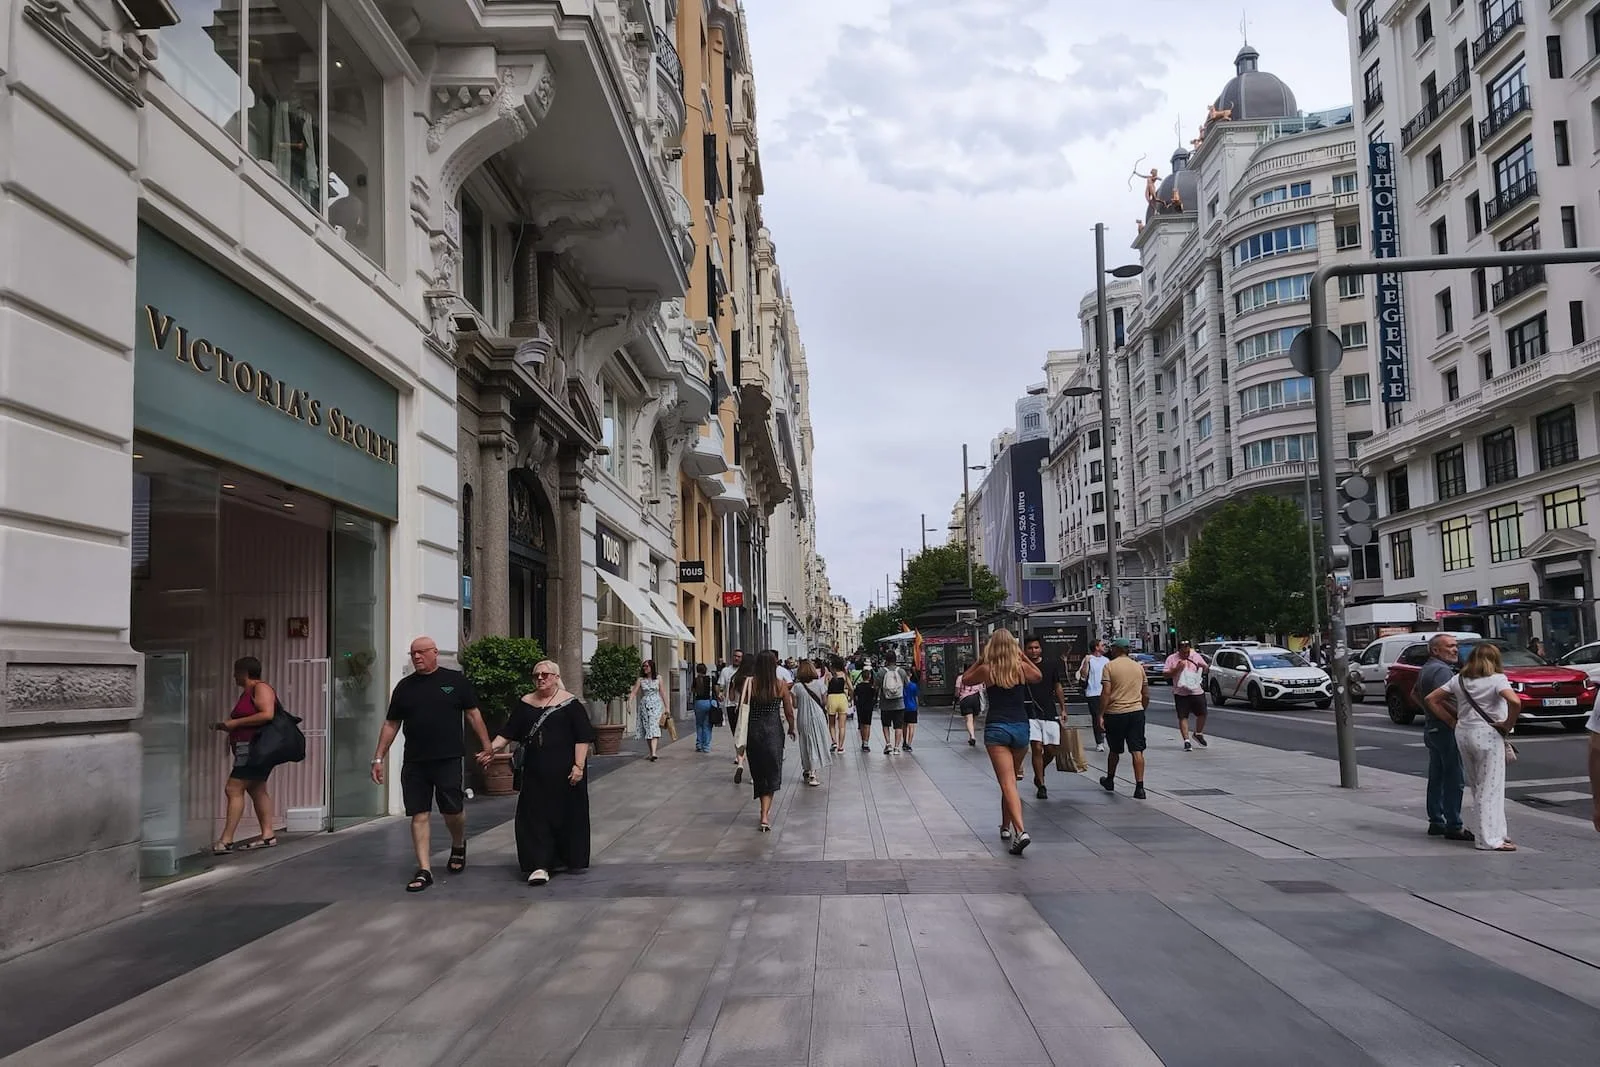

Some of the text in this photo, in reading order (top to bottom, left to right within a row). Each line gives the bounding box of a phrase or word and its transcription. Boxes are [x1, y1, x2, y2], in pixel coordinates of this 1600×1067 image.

[1381, 272, 1404, 398] REGENTE
[145, 304, 398, 465] VICTORIA'S SECRET
[1018, 491, 1026, 514] Ultra
[1018, 514, 1026, 531] S26
[1029, 522, 1037, 551] Galaxy
[601, 533, 620, 566] TOUS
[681, 568, 703, 576] TOUS
